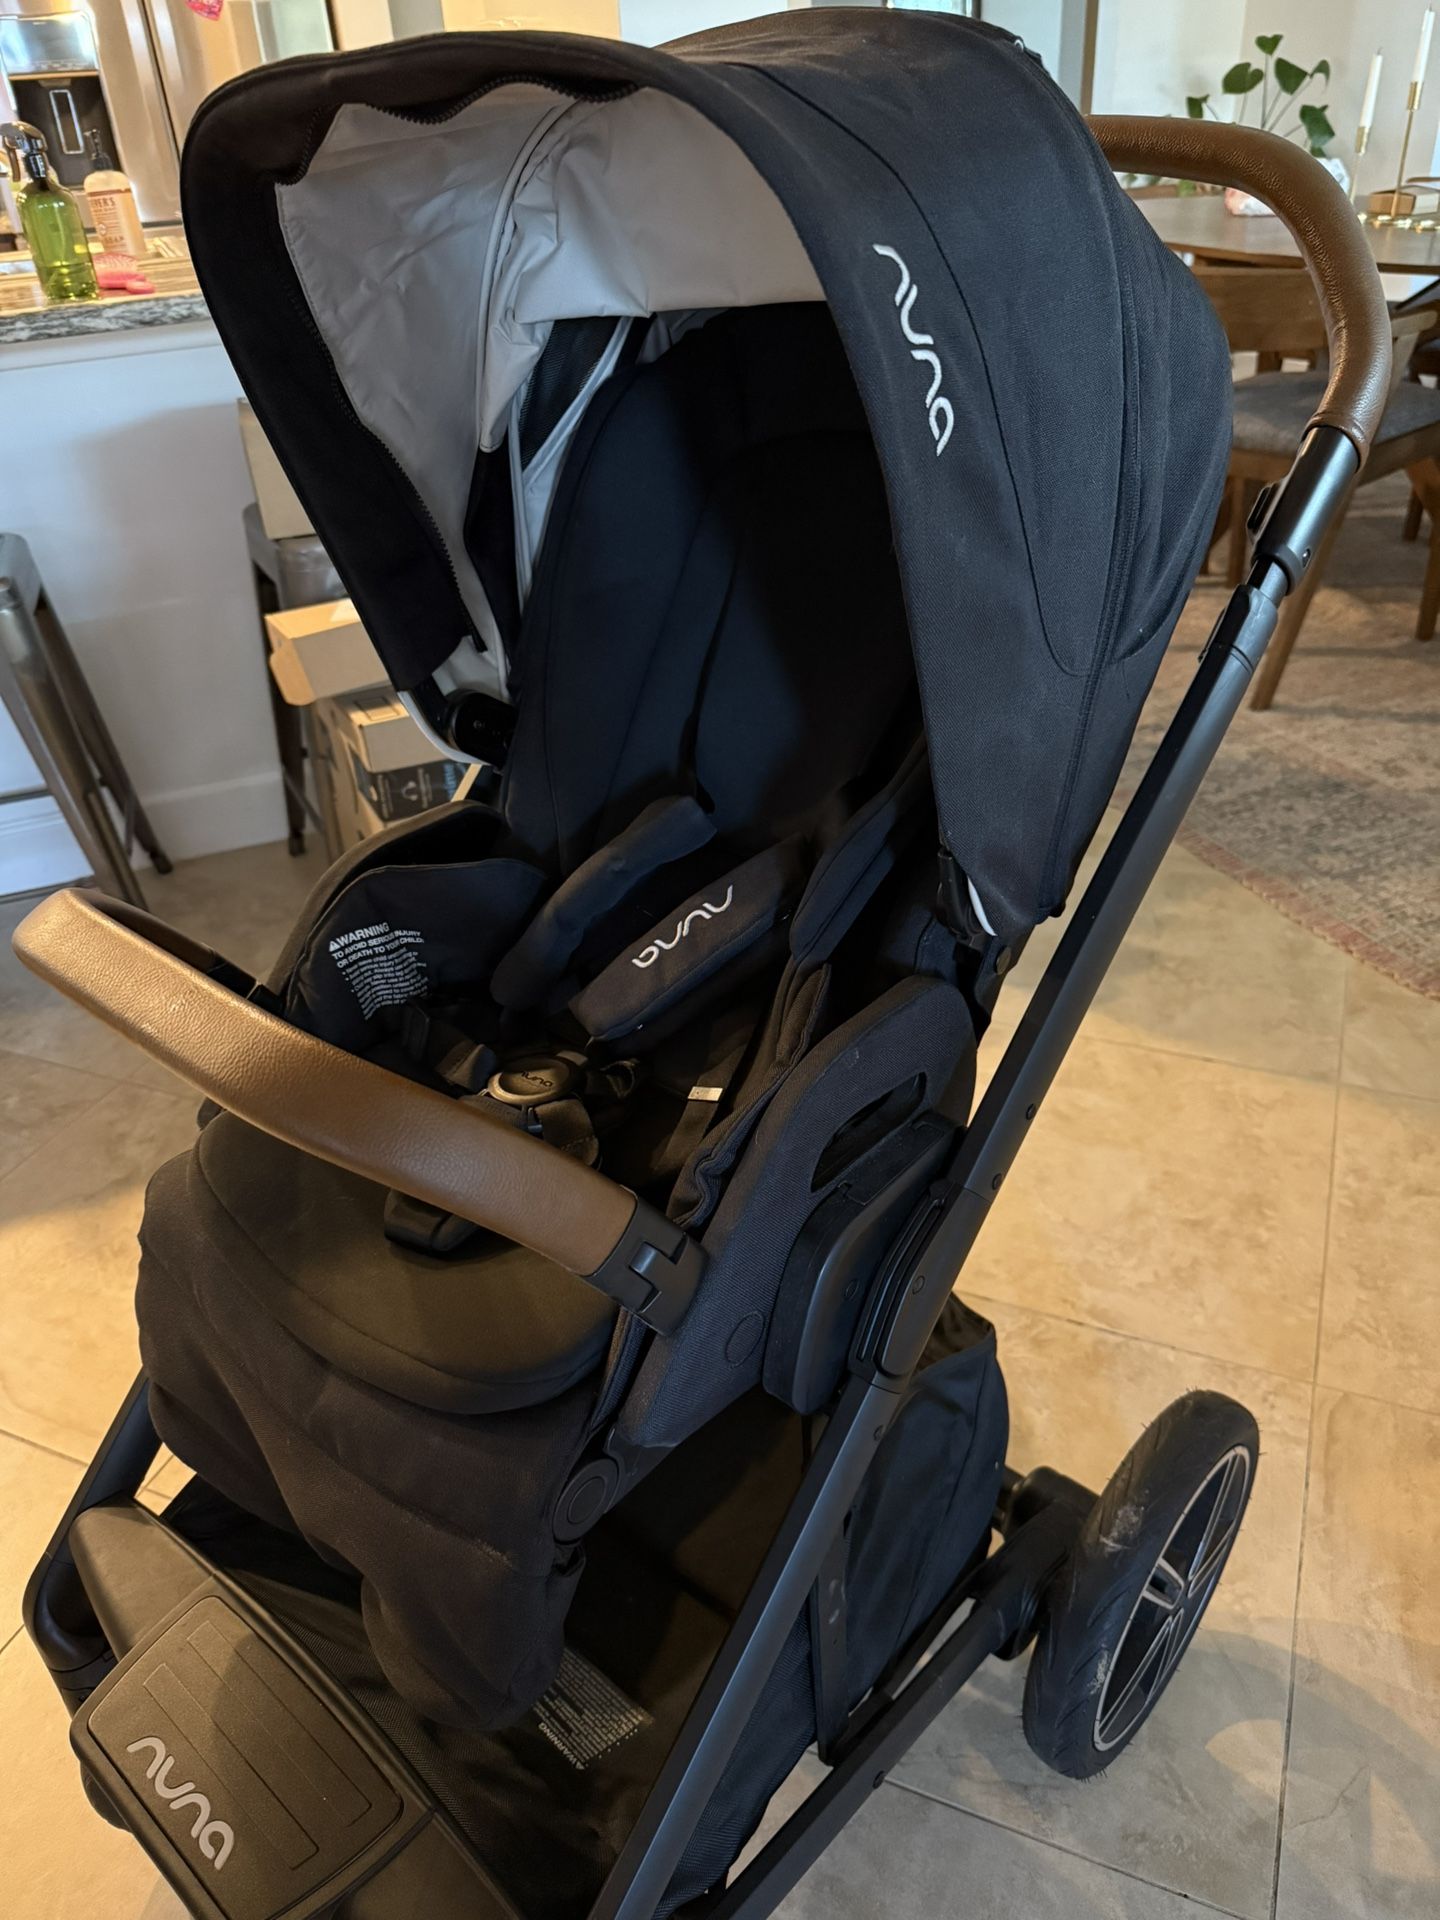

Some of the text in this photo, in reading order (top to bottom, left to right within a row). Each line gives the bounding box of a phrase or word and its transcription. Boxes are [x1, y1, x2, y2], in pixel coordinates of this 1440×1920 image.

[872, 243, 954, 456] nuna
[331, 929, 421, 960] TO AVOID SERIOUS INJURY
[336, 922, 390, 947] WARNING
[631, 884, 733, 968] nuna
[336, 958, 349, 968] OR
[348, 948, 373, 962] DEATH
[373, 945, 386, 954] TO
[538, 1722, 577, 1765] WARNING
[126, 1735, 235, 1872] nuna
